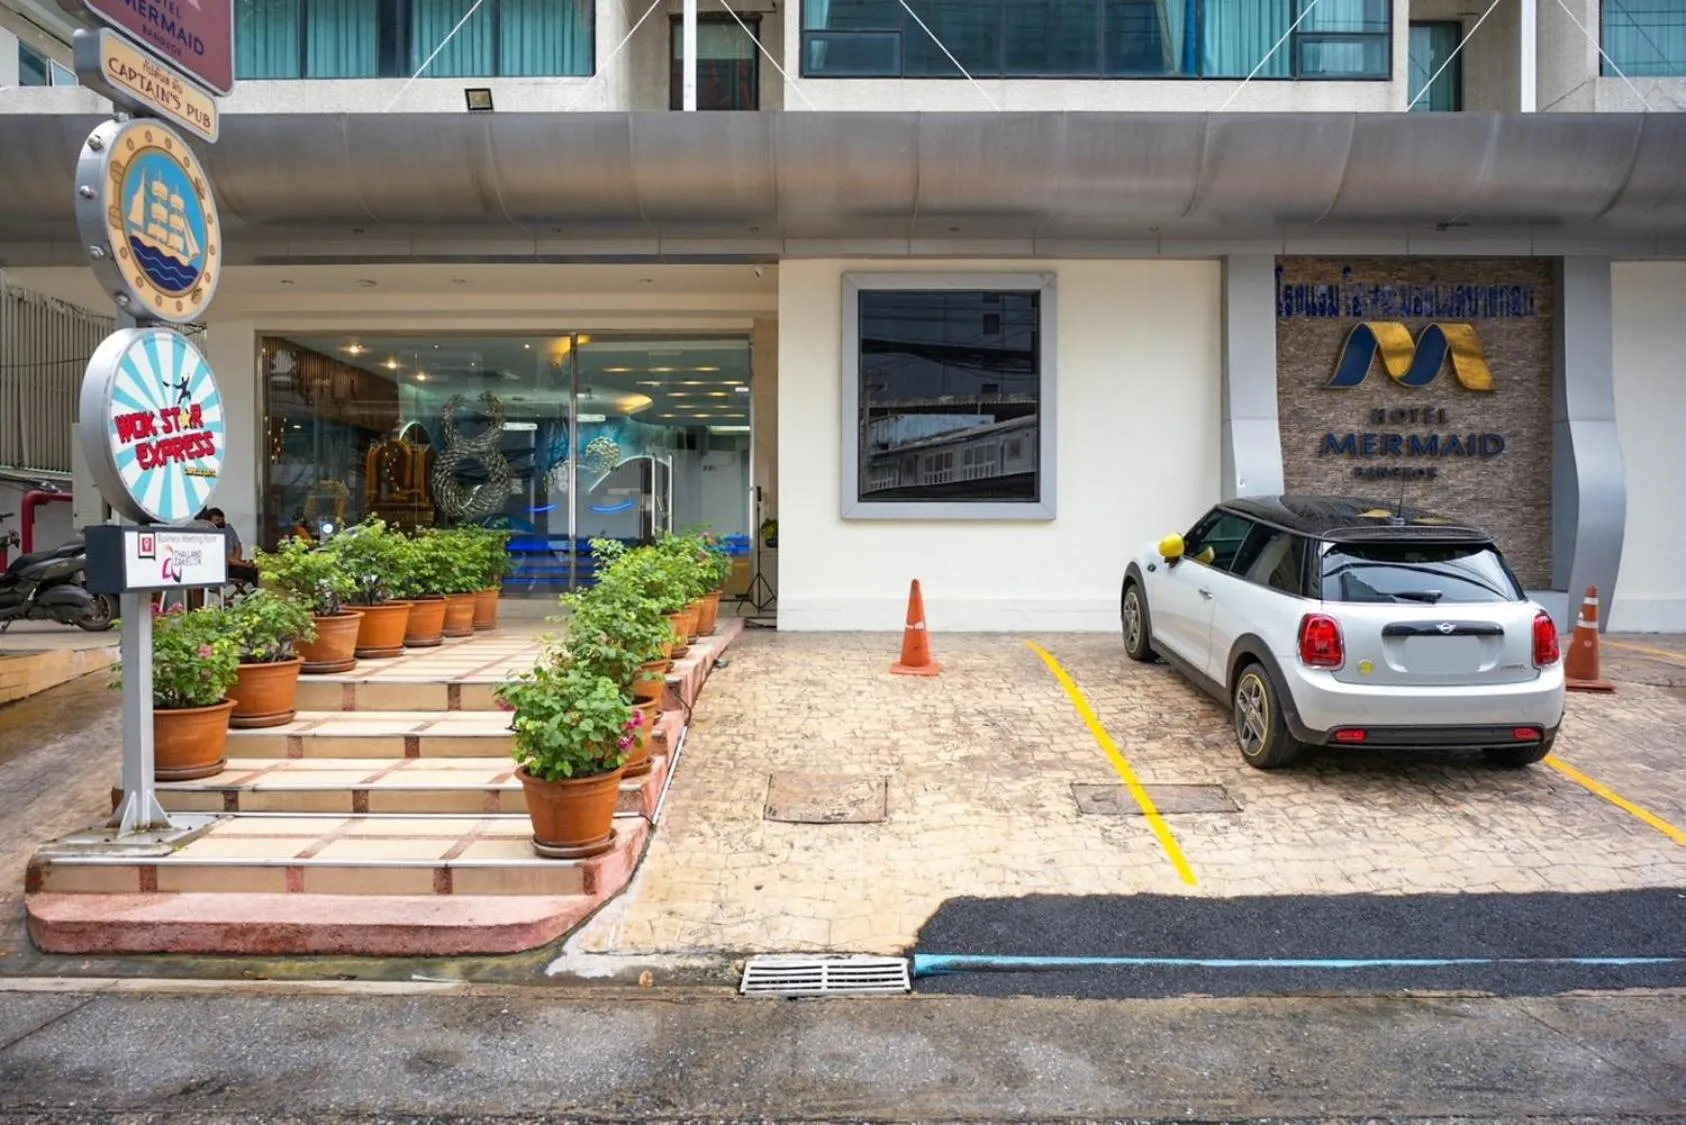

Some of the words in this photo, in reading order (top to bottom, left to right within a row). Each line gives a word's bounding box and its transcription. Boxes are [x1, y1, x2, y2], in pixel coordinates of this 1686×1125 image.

[108, 57, 181, 110] CAPTAIN'S
[186, 103, 211, 128] PUB
[1370, 408, 1449, 424] HOTEL
[135, 430, 216, 471] EXPRESS
[1321, 432, 1506, 458] MERMAID
